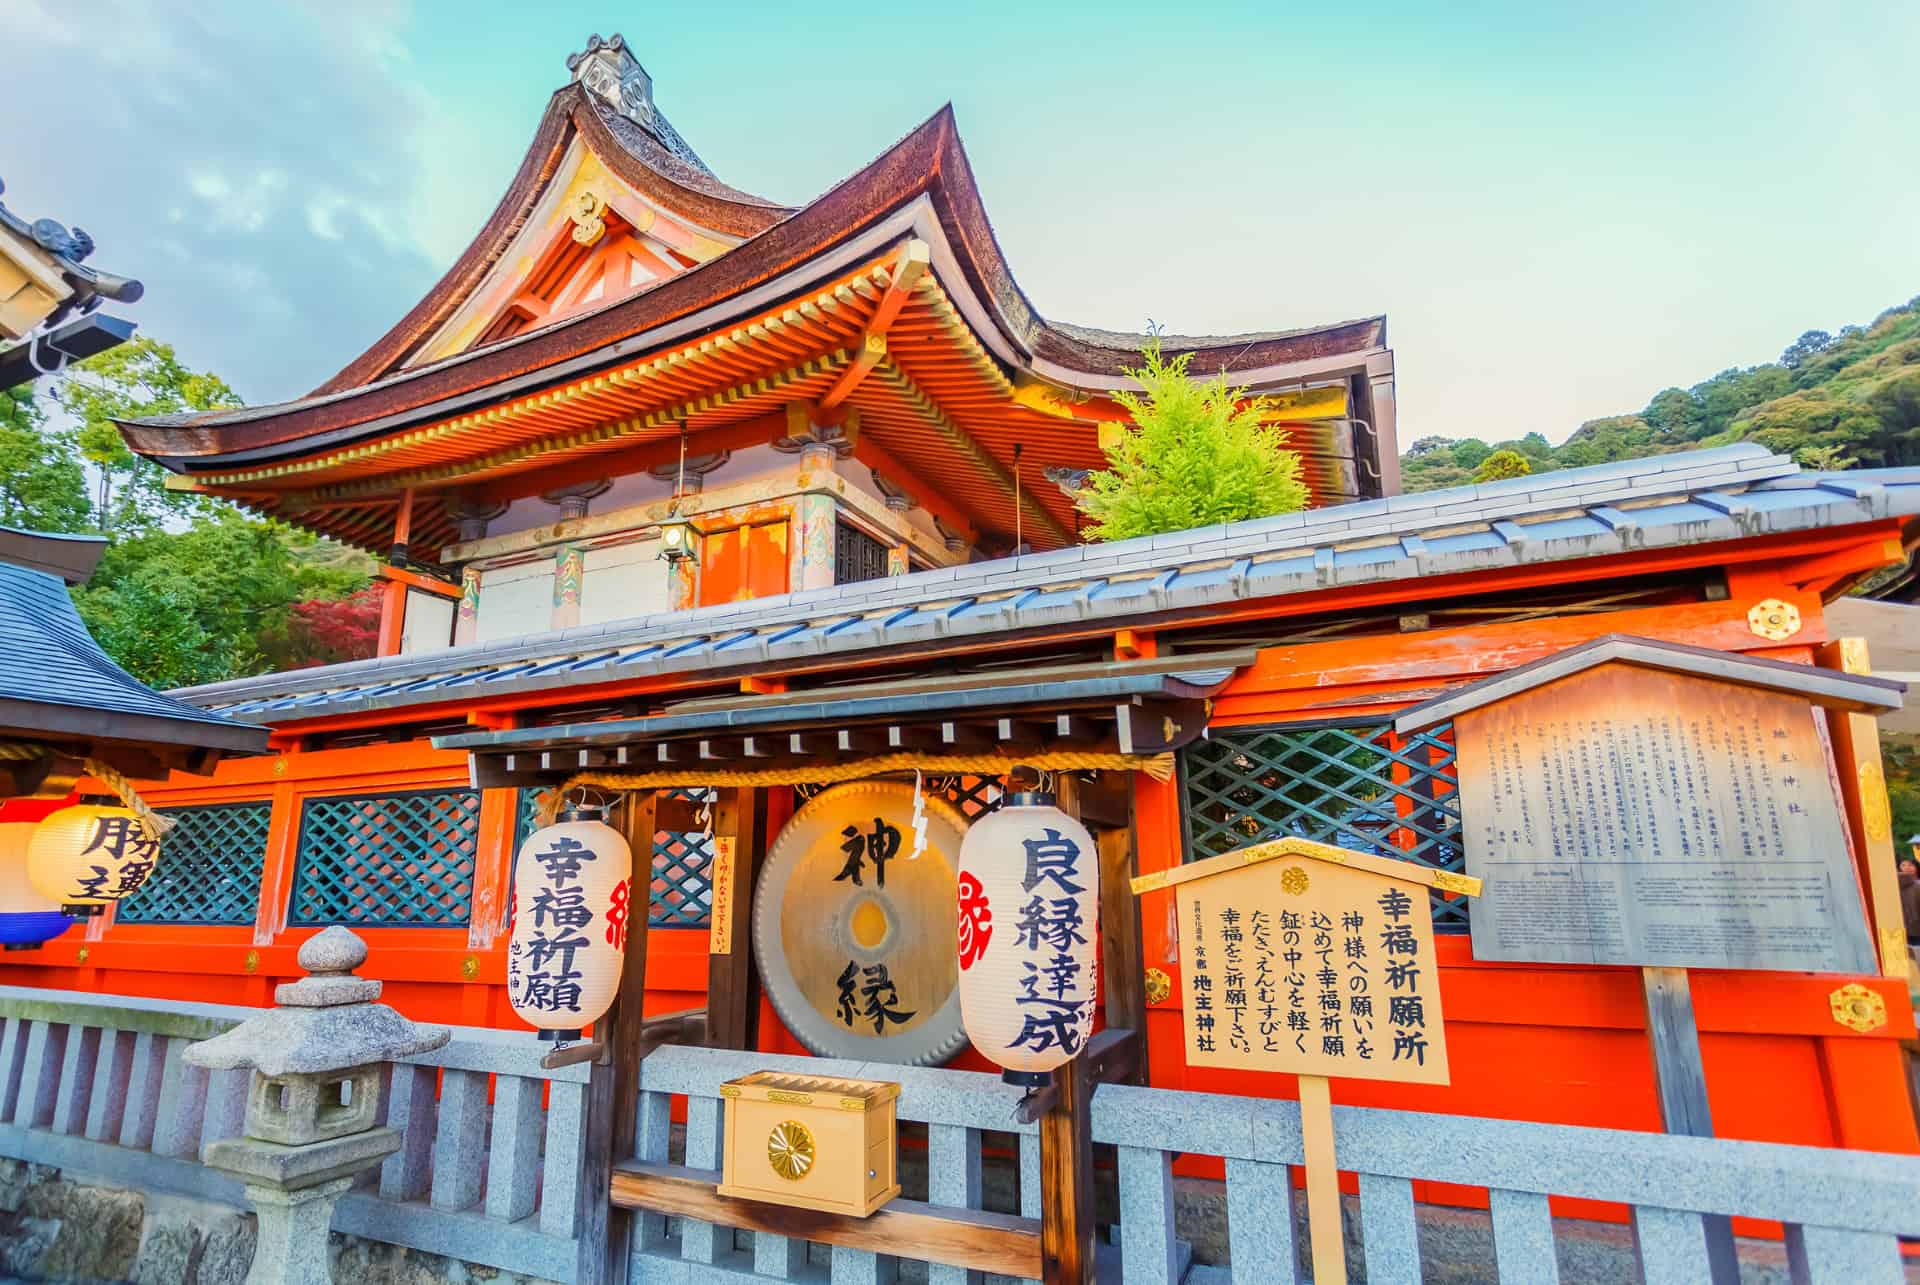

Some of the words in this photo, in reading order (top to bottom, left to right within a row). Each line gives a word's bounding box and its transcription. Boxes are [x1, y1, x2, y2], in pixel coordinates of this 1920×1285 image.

[523, 837, 598, 1012] 幸福祈願
[1004, 828, 1088, 1056] 良縁達成
[1219, 907, 1251, 1053] 幸福をご祈願下さい。
[1251, 910, 1281, 1052] たたき、えんむすびと
[1280, 909, 1311, 1054] 鉦の中心を軽く
[1310, 911, 1346, 1057] 込めて幸福祈願
[1340, 910, 1375, 1060] 神様への願いを
[1377, 887, 1429, 1067] 幸福祈願所
[1193, 974, 1216, 1053] 地主神社
